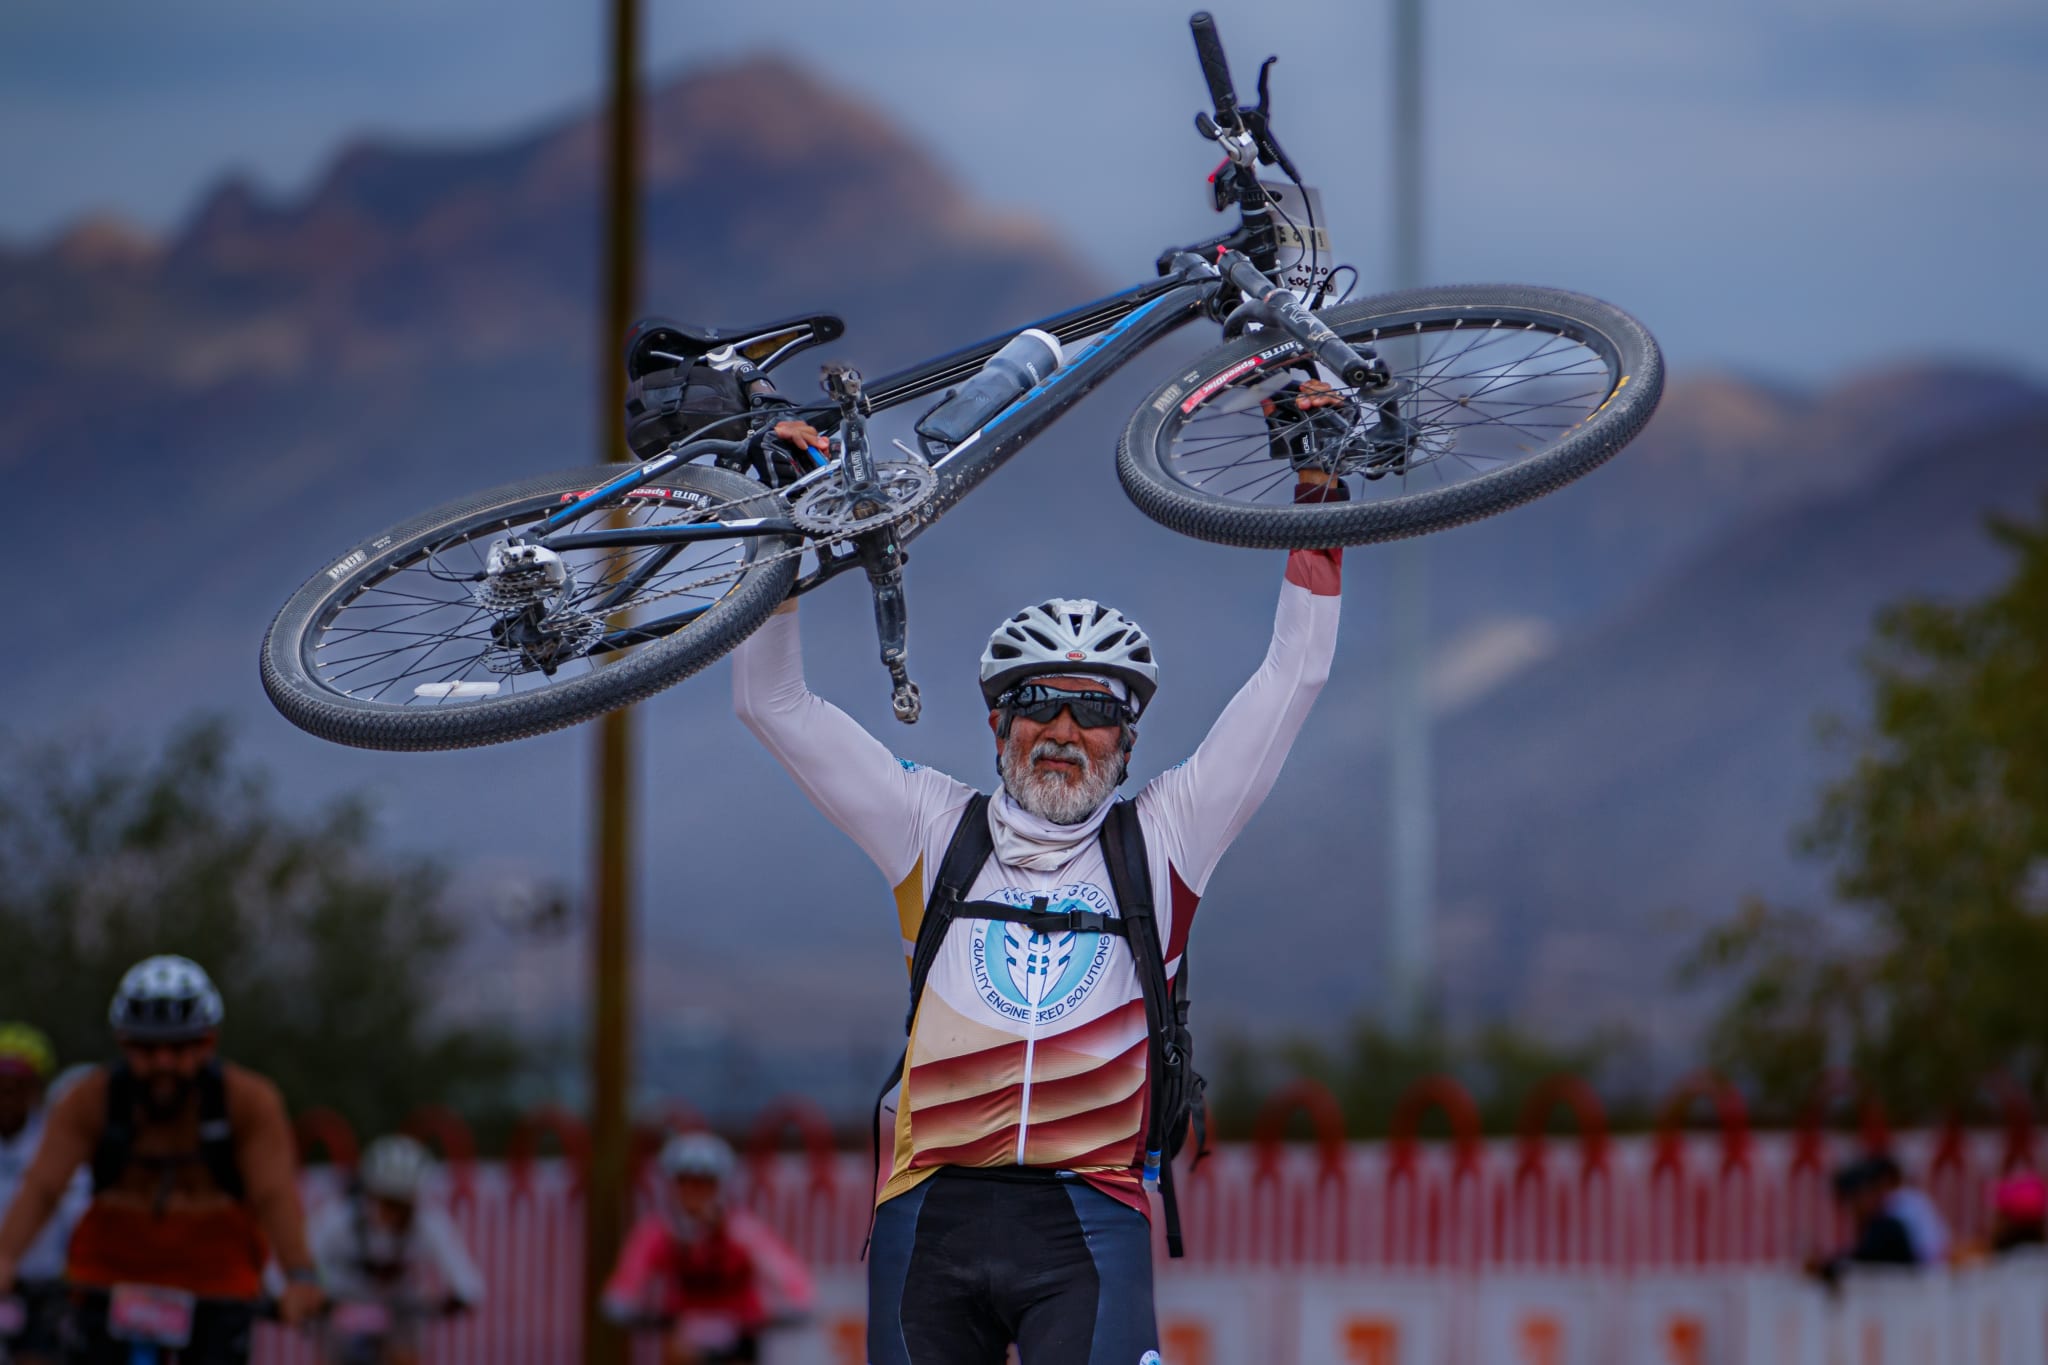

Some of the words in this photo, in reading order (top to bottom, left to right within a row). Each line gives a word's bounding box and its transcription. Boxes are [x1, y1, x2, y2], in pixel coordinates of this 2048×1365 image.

[672, 490, 700, 502] WTB
[973, 938, 992, 990] QUALITY
[1066, 935, 1111, 1008] SOLUTIONS
